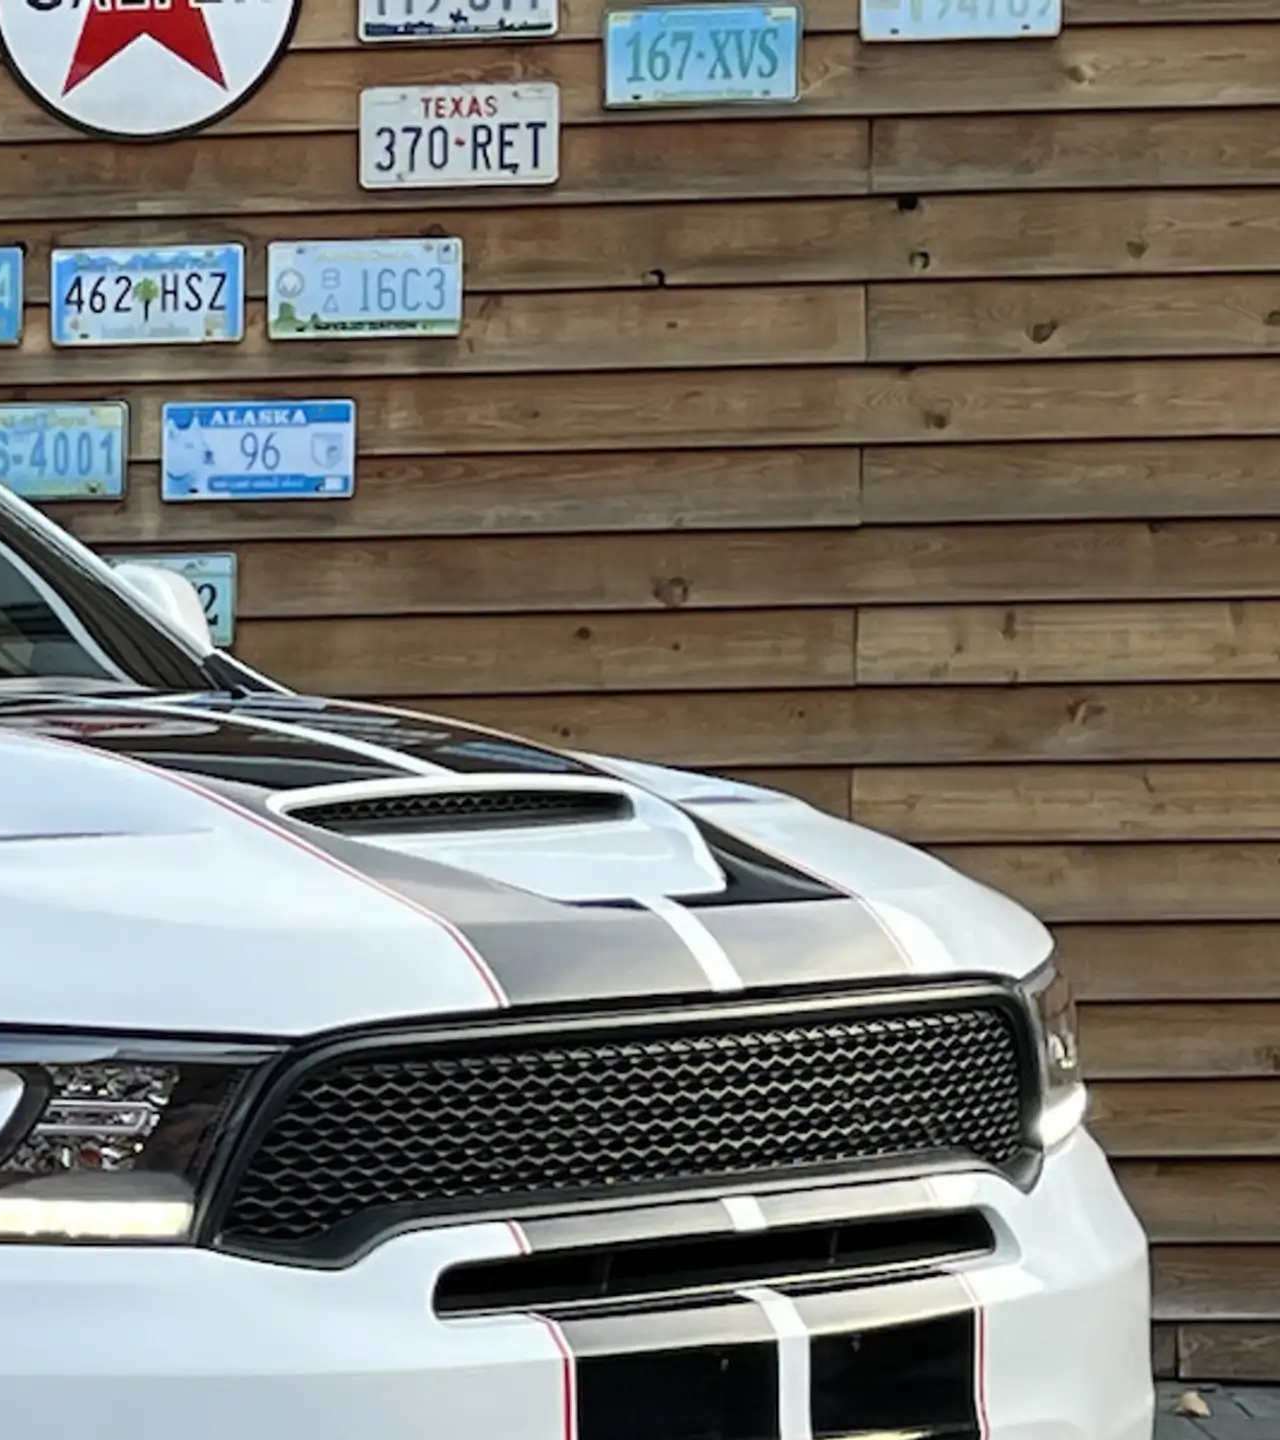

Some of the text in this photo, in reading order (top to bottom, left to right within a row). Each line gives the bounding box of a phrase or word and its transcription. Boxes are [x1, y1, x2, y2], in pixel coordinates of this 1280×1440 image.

[423, 97, 498, 119] TEXAS
[375, 122, 547, 173] 370 RET
[65, 272, 227, 313] 462 HSZ
[211, 408, 307, 426] ALASKA
[240, 432, 280, 471] 96
